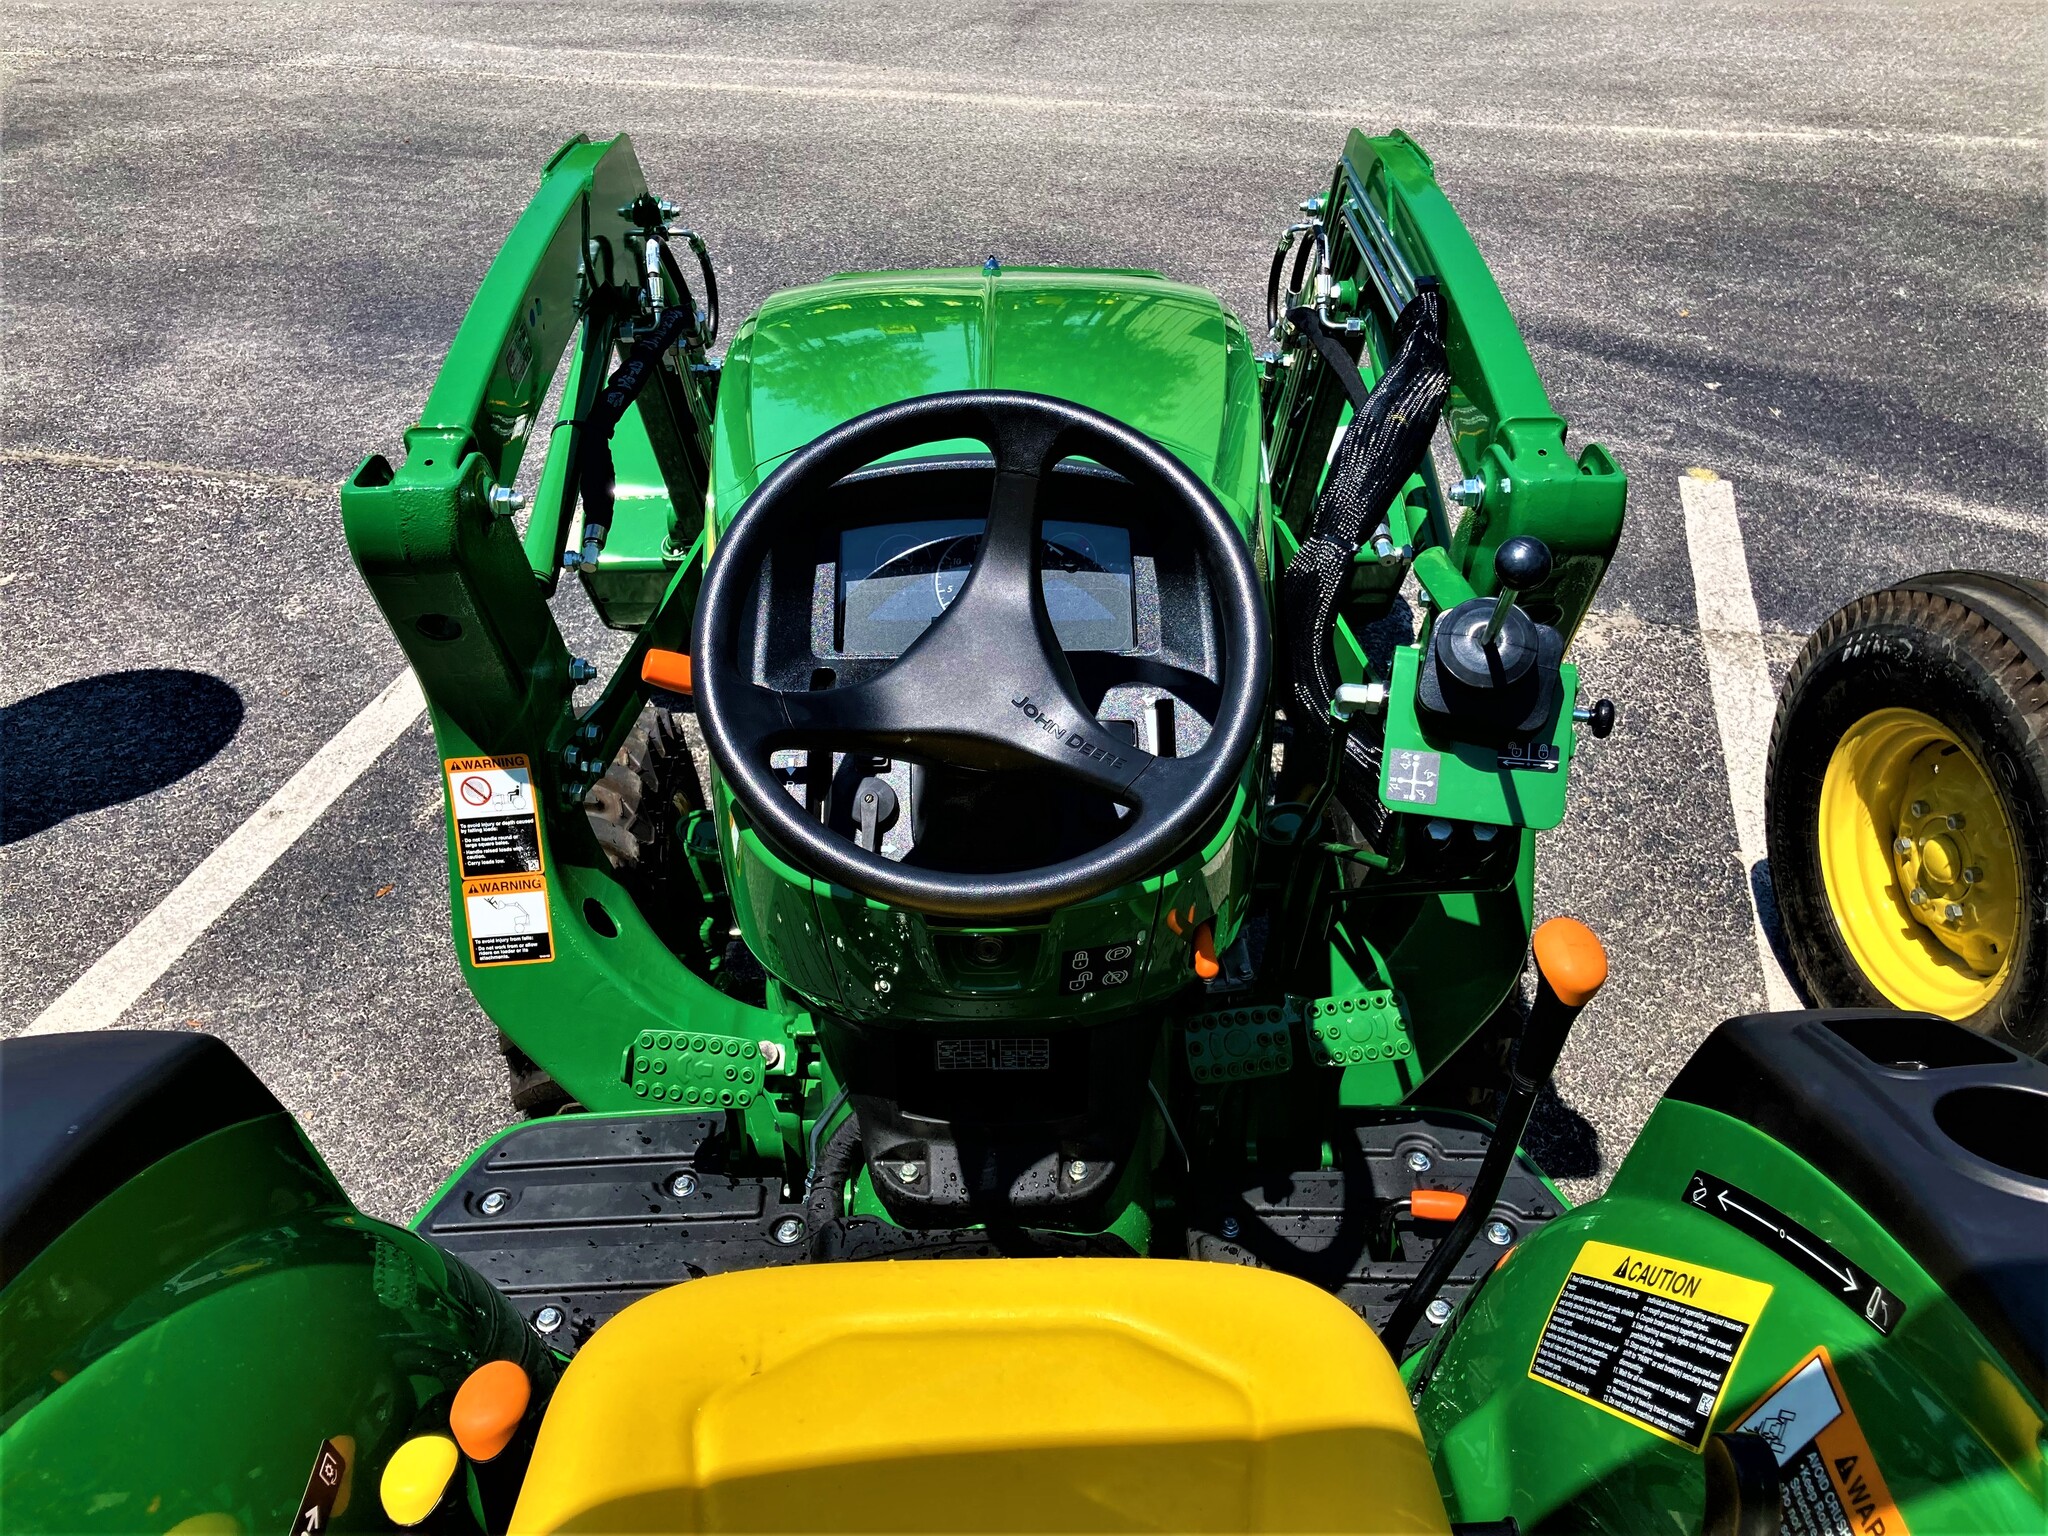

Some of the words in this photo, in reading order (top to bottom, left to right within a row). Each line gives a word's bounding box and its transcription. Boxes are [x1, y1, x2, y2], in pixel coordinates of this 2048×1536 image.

[1011, 696, 1067, 740] JOHN
[1065, 733, 1128, 769] DEERE
[461, 756, 524, 770] WARNING
[479, 878, 541, 893] WARNING
[1628, 1261, 1702, 1298] CAUTION
[1807, 1452, 1830, 1491] AVOID
